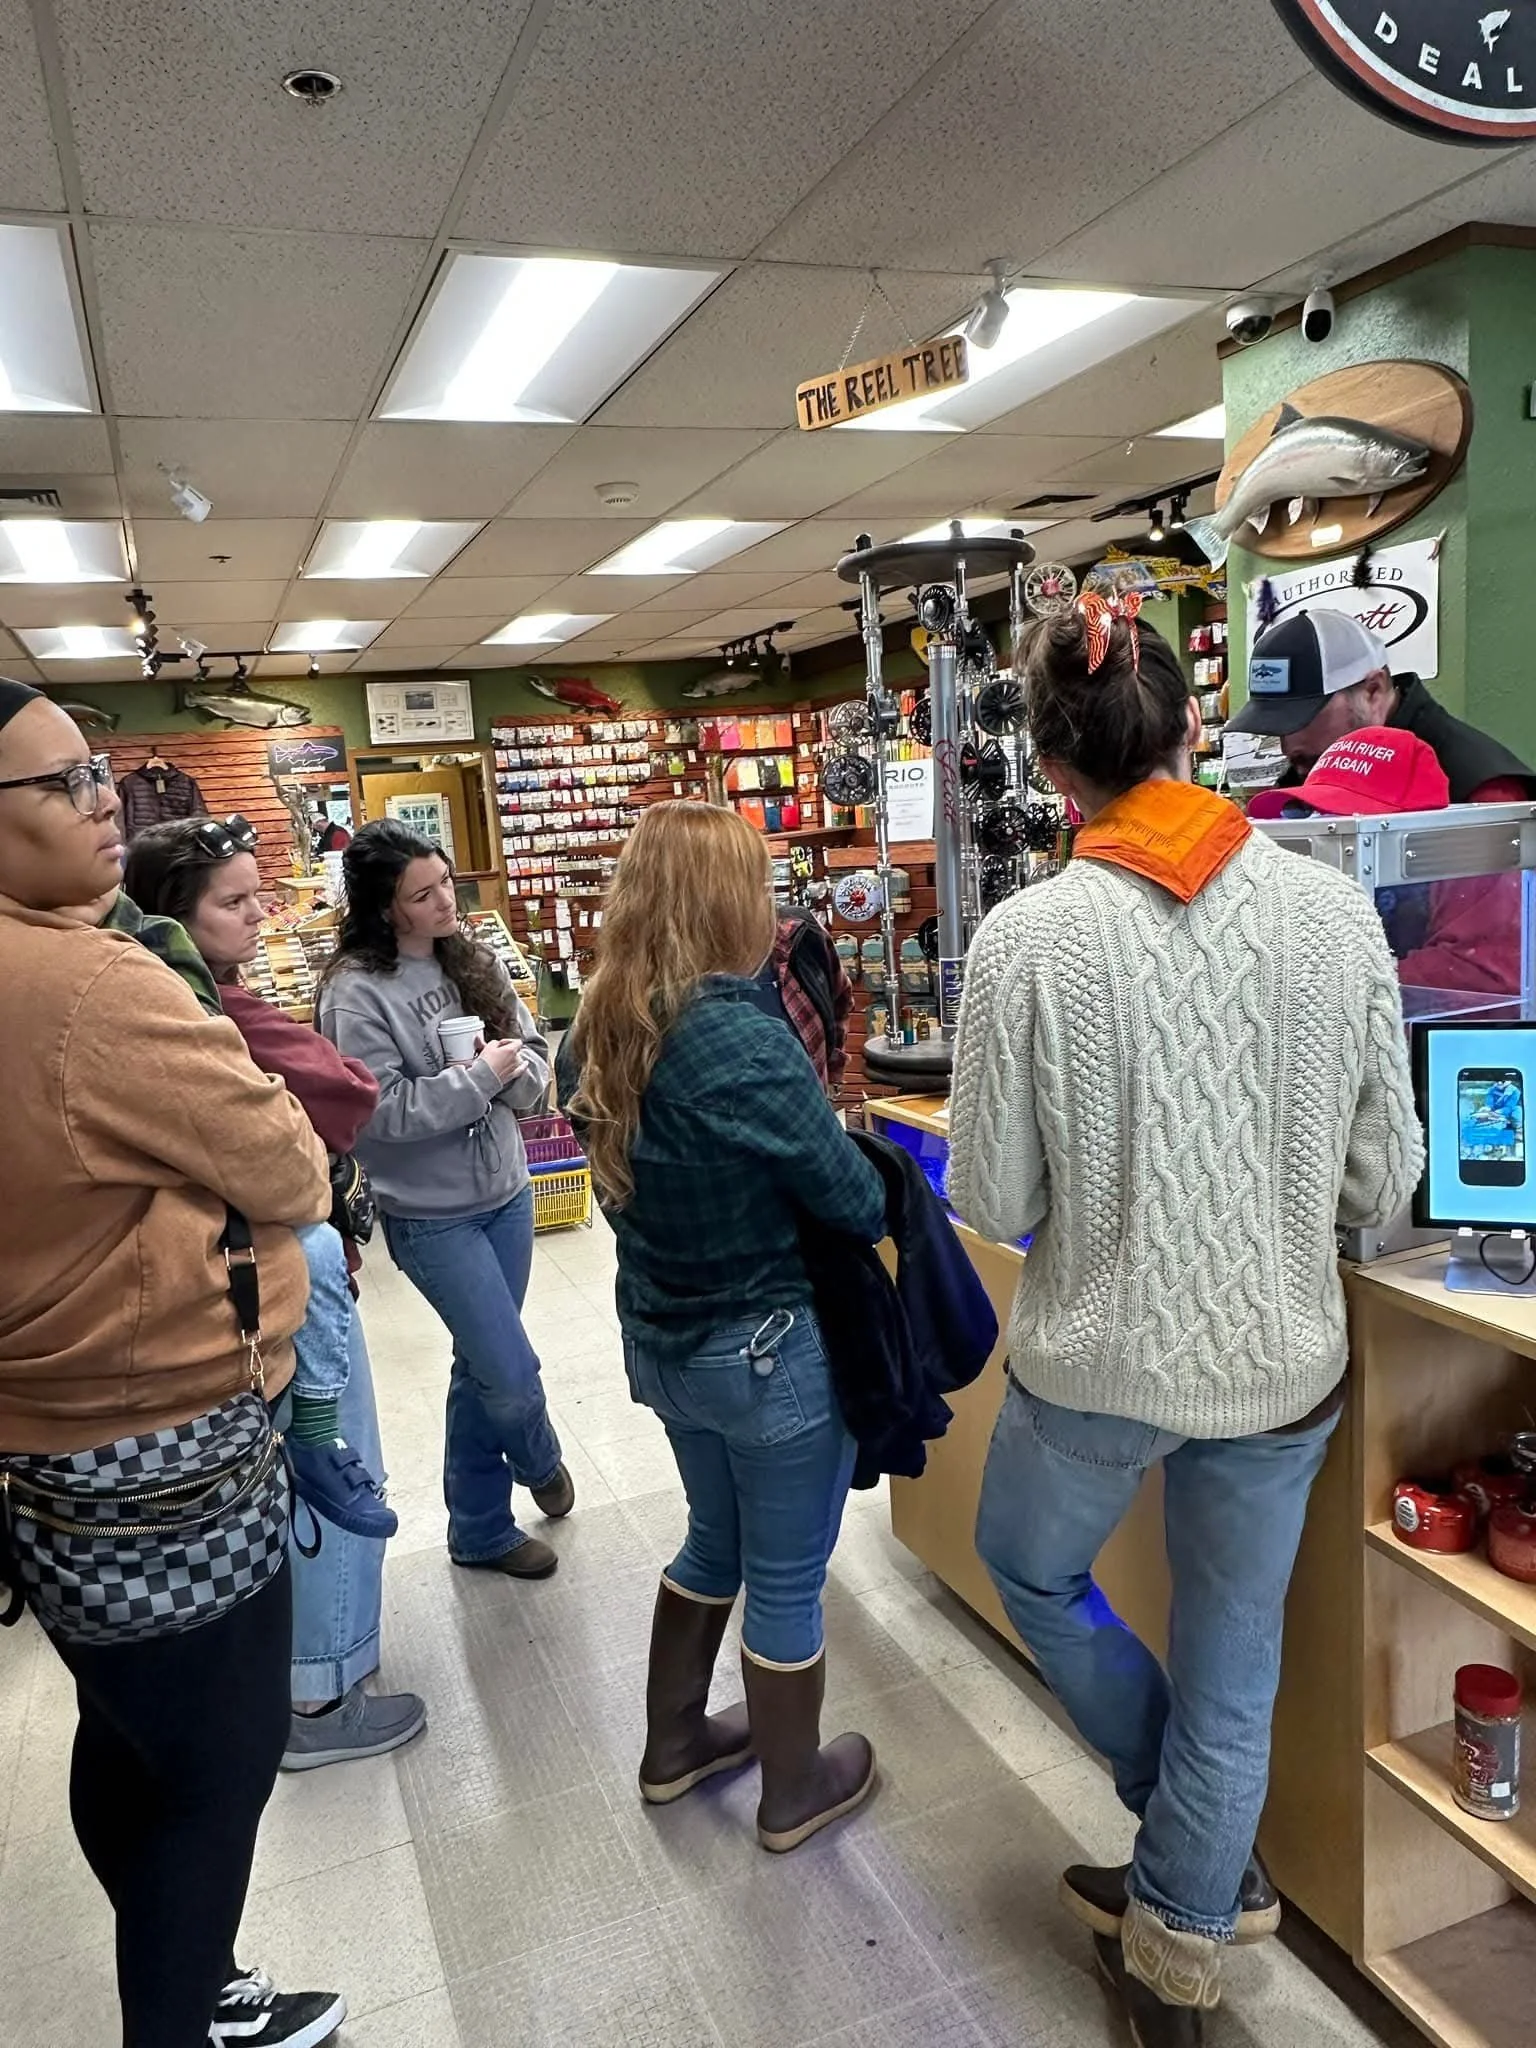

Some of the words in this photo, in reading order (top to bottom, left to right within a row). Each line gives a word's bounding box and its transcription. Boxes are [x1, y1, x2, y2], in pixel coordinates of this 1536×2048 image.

[798, 382, 841, 426] THE
[845, 364, 900, 413] REEL
[903, 340, 968, 392] TREE
[1355, 742, 1396, 762] RIVER
[884, 767, 925, 783] RIO
[1330, 756, 1374, 777] AGAIN
